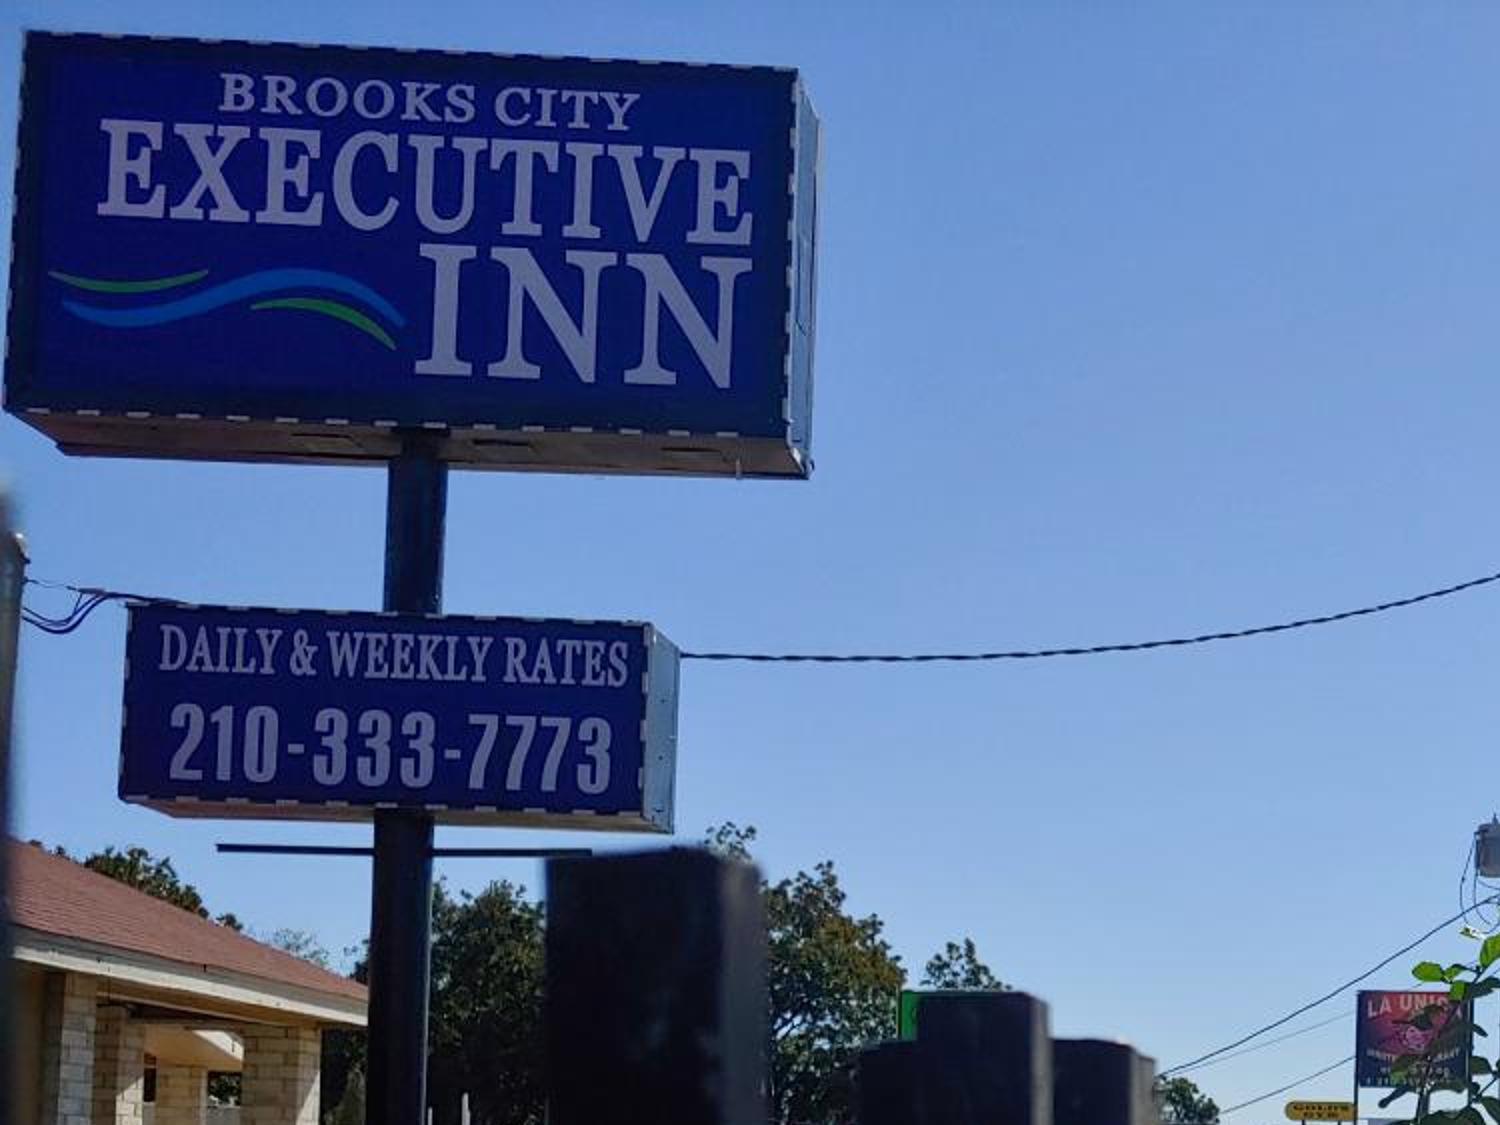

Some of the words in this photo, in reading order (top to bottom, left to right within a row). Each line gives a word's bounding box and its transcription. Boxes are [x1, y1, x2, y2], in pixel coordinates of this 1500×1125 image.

[219, 73, 476, 124] BROOKS
[494, 86, 641, 131] CITY
[96, 118, 754, 246] EXECUTIVE
[414, 243, 753, 389] INN
[159, 624, 284, 674] DAILY
[289, 629, 318, 676] &
[326, 630, 495, 682] WEEKLY
[503, 636, 629, 688] RATES
[169, 702, 612, 794] 210-333-7773
[1367, 994, 1392, 1018] LA
